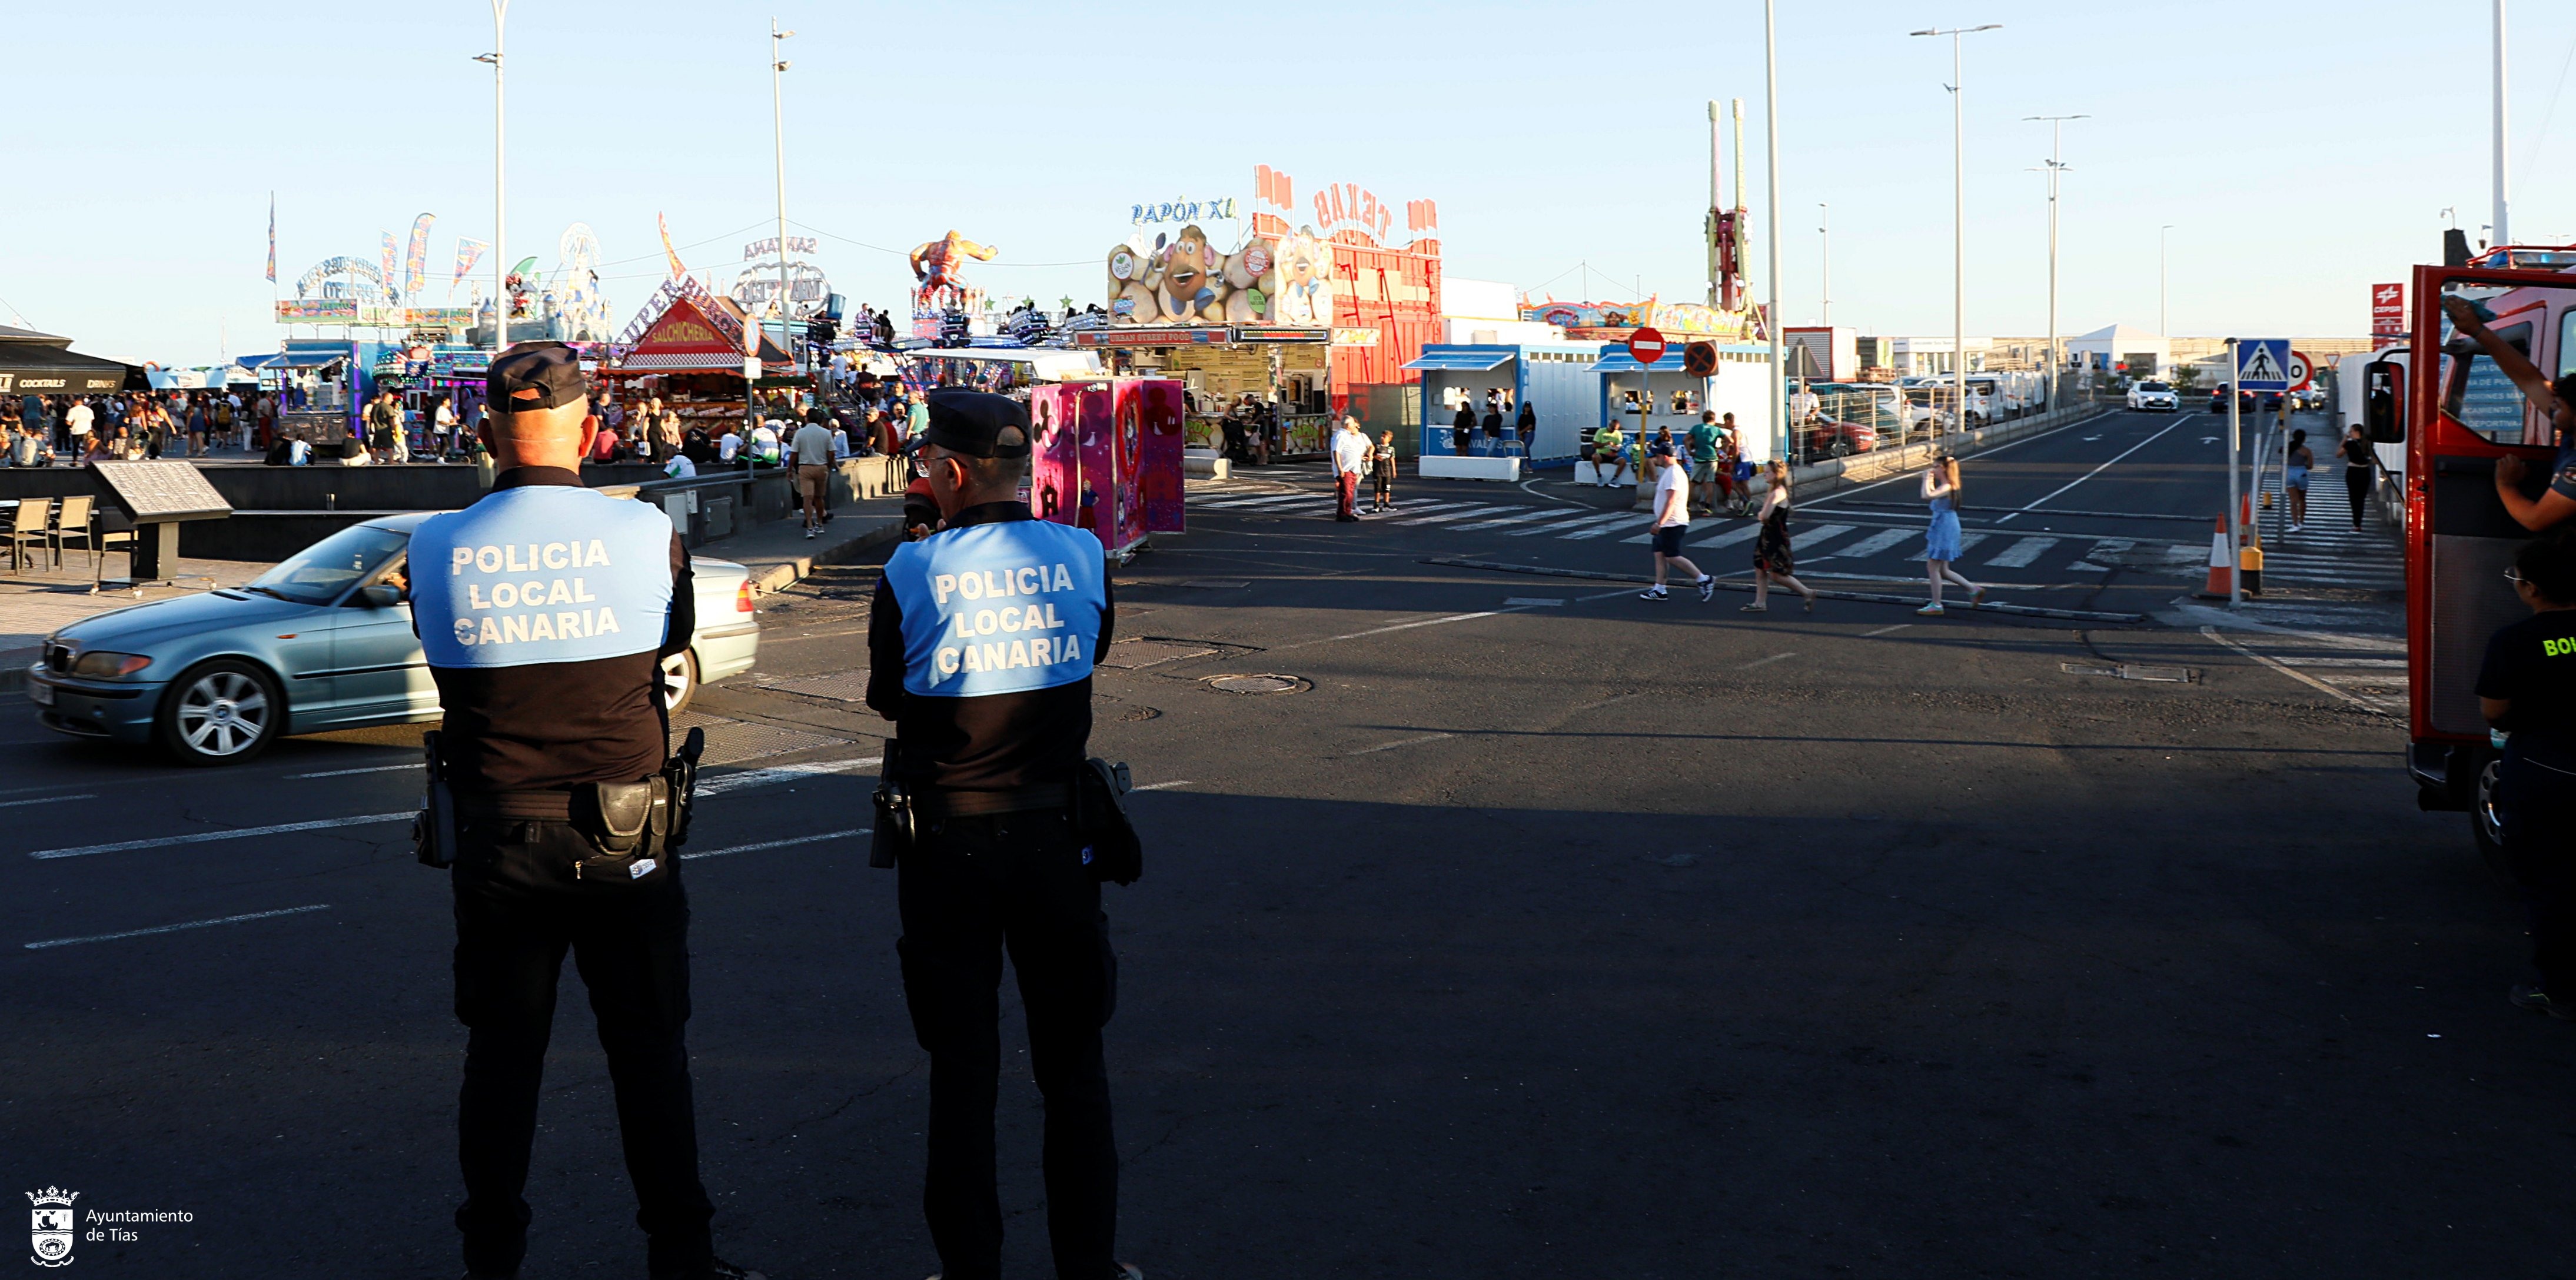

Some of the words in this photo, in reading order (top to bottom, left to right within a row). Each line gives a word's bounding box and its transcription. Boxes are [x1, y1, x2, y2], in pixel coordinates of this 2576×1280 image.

[1131, 195, 1201, 224] PAPÓN
[1208, 197, 1235, 220] XL
[615, 279, 680, 358] SUPER
[653, 322, 714, 343] SALCHICHERIA
[1110, 334, 1135, 343] URBAN
[1138, 333, 1167, 341] STREET
[1169, 333, 1191, 341] FOOD
[19, 379, 66, 388] COCKTAILS
[87, 380, 116, 388] DRINKS
[2291, 365, 2302, 378] 0
[453, 539, 611, 575] POLICIA
[469, 578, 596, 609] LOCAL
[935, 564, 1075, 604] POLICIA
[454, 607, 620, 646] CANARIA
[955, 603, 1065, 638] LOCAL
[938, 634, 1081, 674] CANARIA
